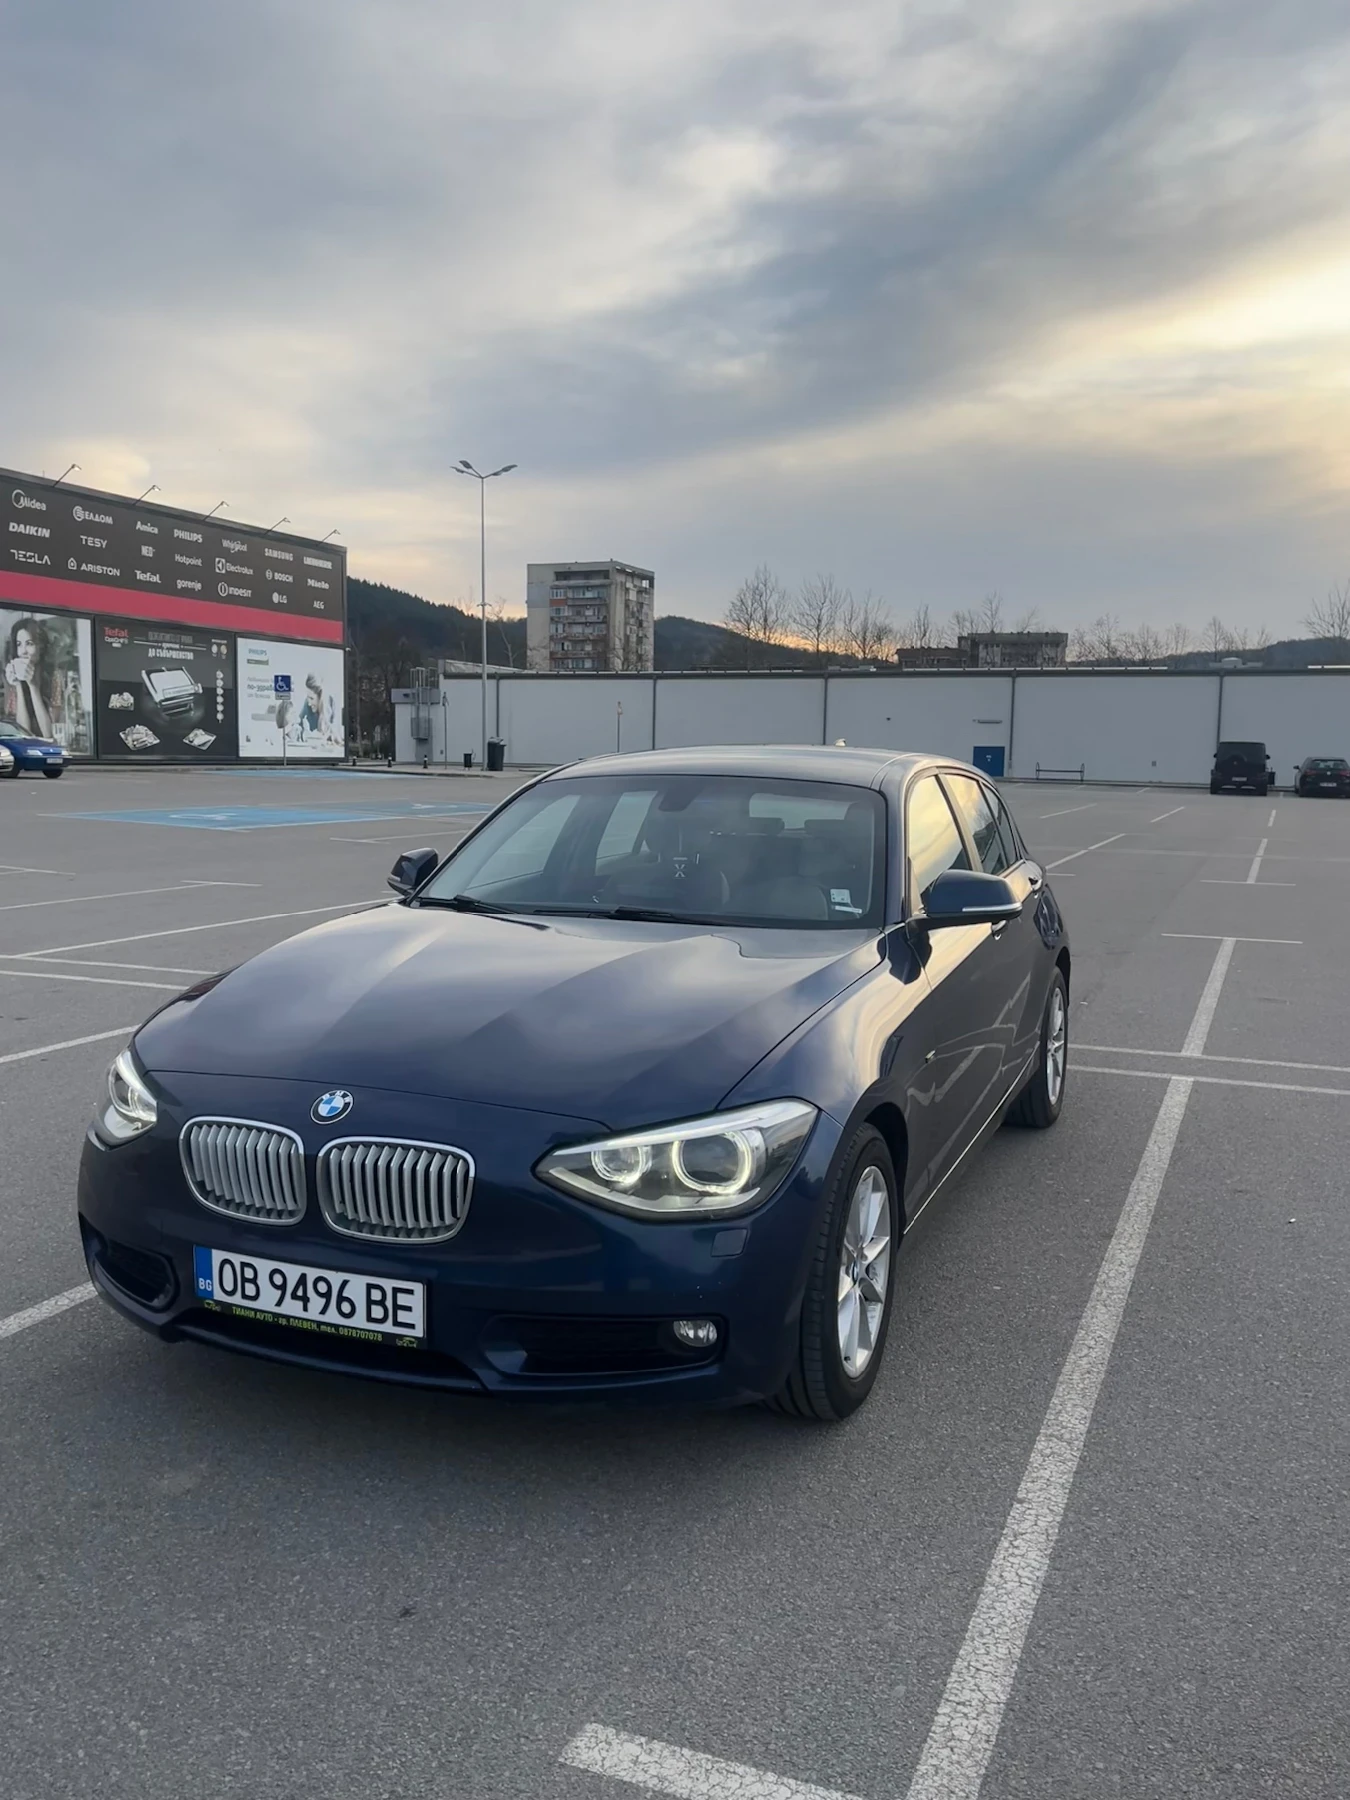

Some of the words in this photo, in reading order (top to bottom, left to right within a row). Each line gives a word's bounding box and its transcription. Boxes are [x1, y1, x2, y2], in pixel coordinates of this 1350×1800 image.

[15, 492, 47, 511] Midea
[8, 522, 51, 538] DAIKIN
[136, 521, 158, 534] Amica
[80, 535, 108, 549] TESY
[174, 529, 203, 543] PHILIPS
[10, 549, 51, 566] TESLA
[175, 554, 203, 567] Hotpoint
[264, 548, 293, 561] SAMSUNG
[80, 563, 121, 577] ARISTON
[226, 562, 254, 575] Electrolux
[134, 570, 162, 584] Tefal
[274, 572, 294, 583] BOSCH
[176, 580, 202, 592] gorenje
[279, 594, 288, 604] LG
[313, 600, 325, 610] AEG
[104, 627, 129, 638] Tefal
[198, 1277, 212, 1292] BG
[218, 1258, 261, 1301] OB
[268, 1268, 356, 1319] 9496
[365, 1282, 416, 1330] BE
[256, 1311, 273, 1322] АУТО
